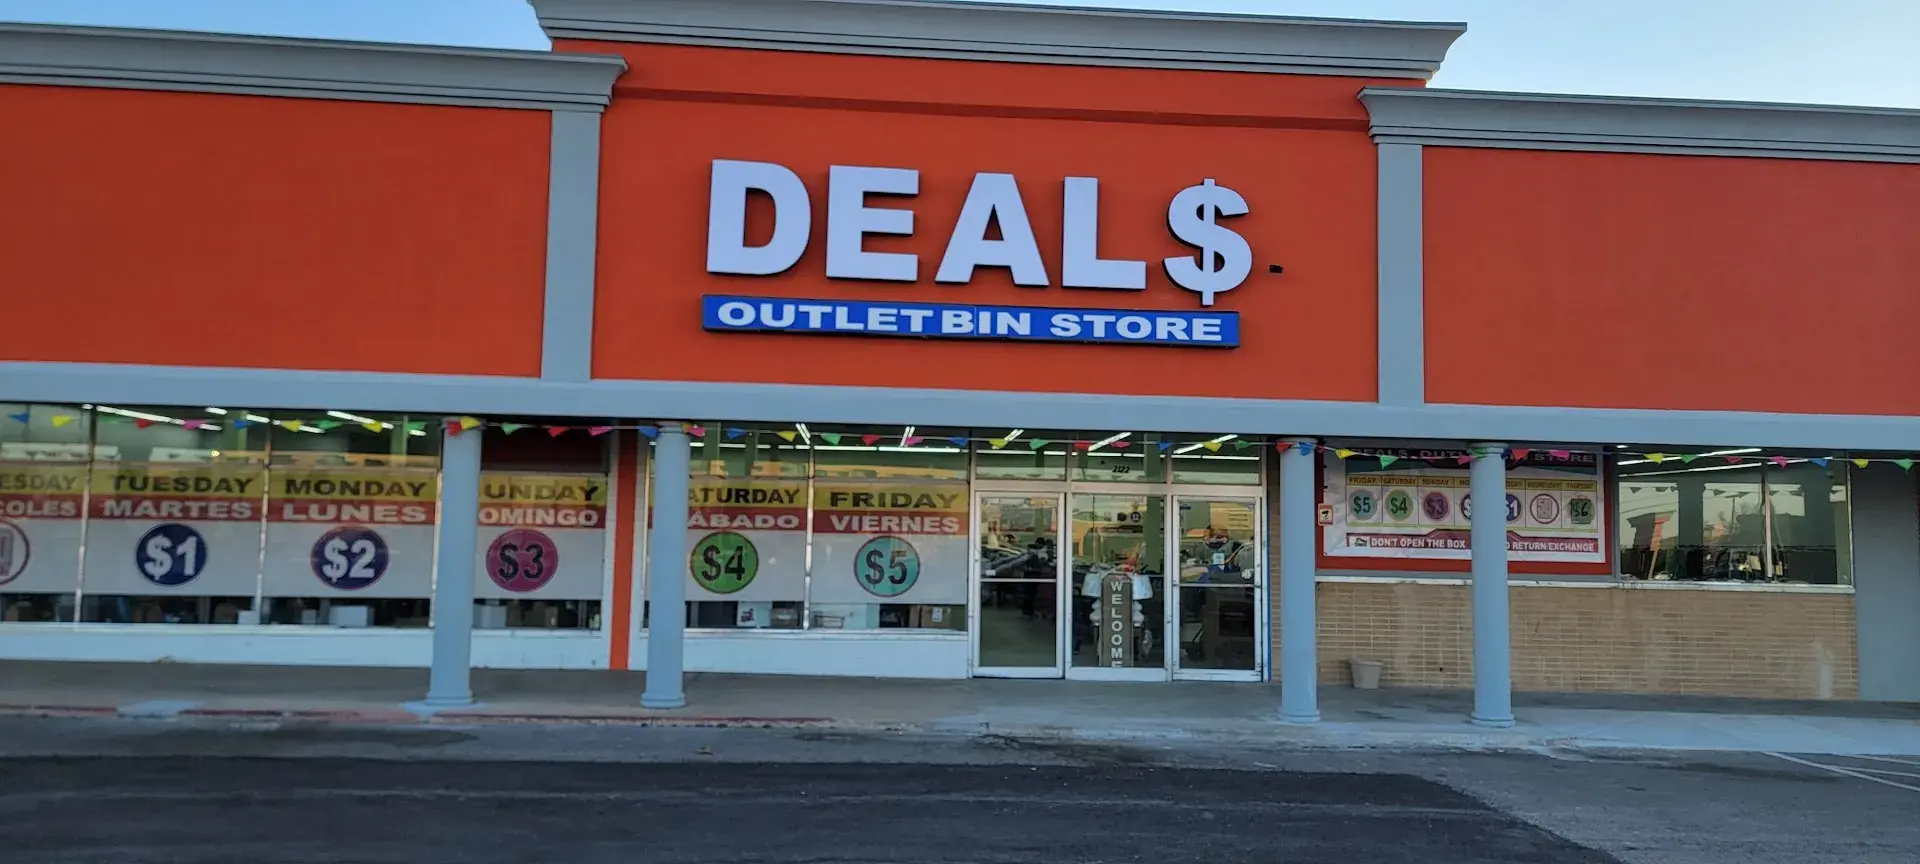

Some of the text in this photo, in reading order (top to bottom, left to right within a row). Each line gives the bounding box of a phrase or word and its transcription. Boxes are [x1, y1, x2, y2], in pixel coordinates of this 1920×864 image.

[706, 159, 1253, 306] DEAL$
[717, 300, 1223, 341] OUTLET BIN STORE
[1112, 465, 1131, 474] 2122
[0, 474, 77, 490] ESDAY
[112, 475, 254, 494] TUESDAY
[284, 479, 428, 498] MONDAY
[1349, 477, 1377, 485] FRIDAY
[1383, 478, 1417, 486] SATURDAY
[1422, 478, 1449, 486] SUNDAY
[484, 483, 599, 502] UNDAY
[688, 487, 800, 505] ATURDAY
[830, 491, 959, 508] FRIDAY
[103, 498, 253, 520] MARTES
[282, 501, 427, 523] LUNES
[1353, 496, 1372, 514] $5
[1390, 496, 1408, 514] $4
[478, 506, 599, 527] OMINGO
[687, 509, 800, 529] ÁBADO
[830, 514, 960, 533] VIERNES
[1371, 536, 1466, 550] DON'T OPEN THE BOX
[143, 533, 198, 581] $1
[322, 536, 377, 583] $2
[498, 541, 544, 583] $3
[702, 544, 746, 584] $4
[864, 548, 908, 588] $5
